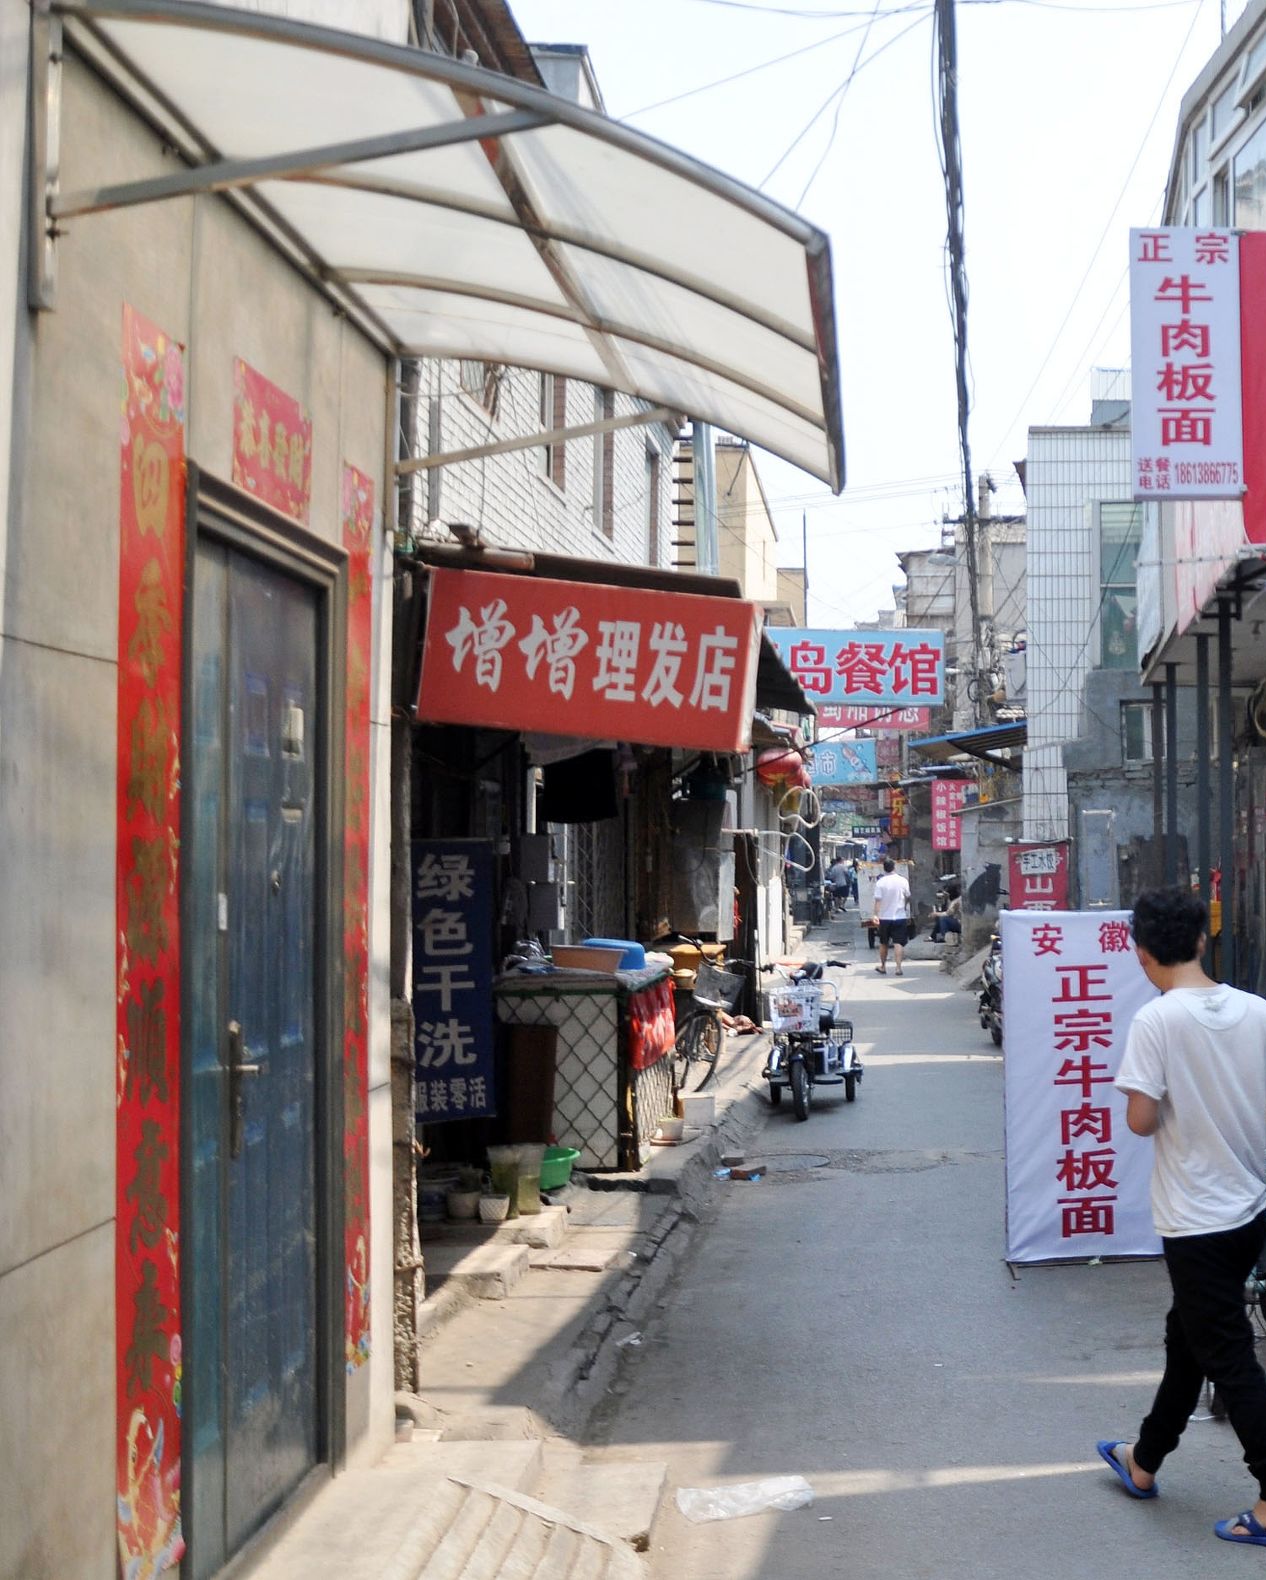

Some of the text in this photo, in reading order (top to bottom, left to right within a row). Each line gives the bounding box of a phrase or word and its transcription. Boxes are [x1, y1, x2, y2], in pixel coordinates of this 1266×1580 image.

[1137, 233, 1230, 265] 正宗
[1154, 274, 1216, 447] 牛肉板面
[1138, 457, 1171, 473] 送餐
[1139, 474, 1171, 490] 电话
[444, 598, 739, 713] 增增理发店
[773, 640, 942, 697] 岛餐馆
[416, 853, 477, 1069] 绿色干洗
[1031, 921, 1130, 956] 安徽
[1052, 963, 1119, 1238] 正宗牛肉板面
